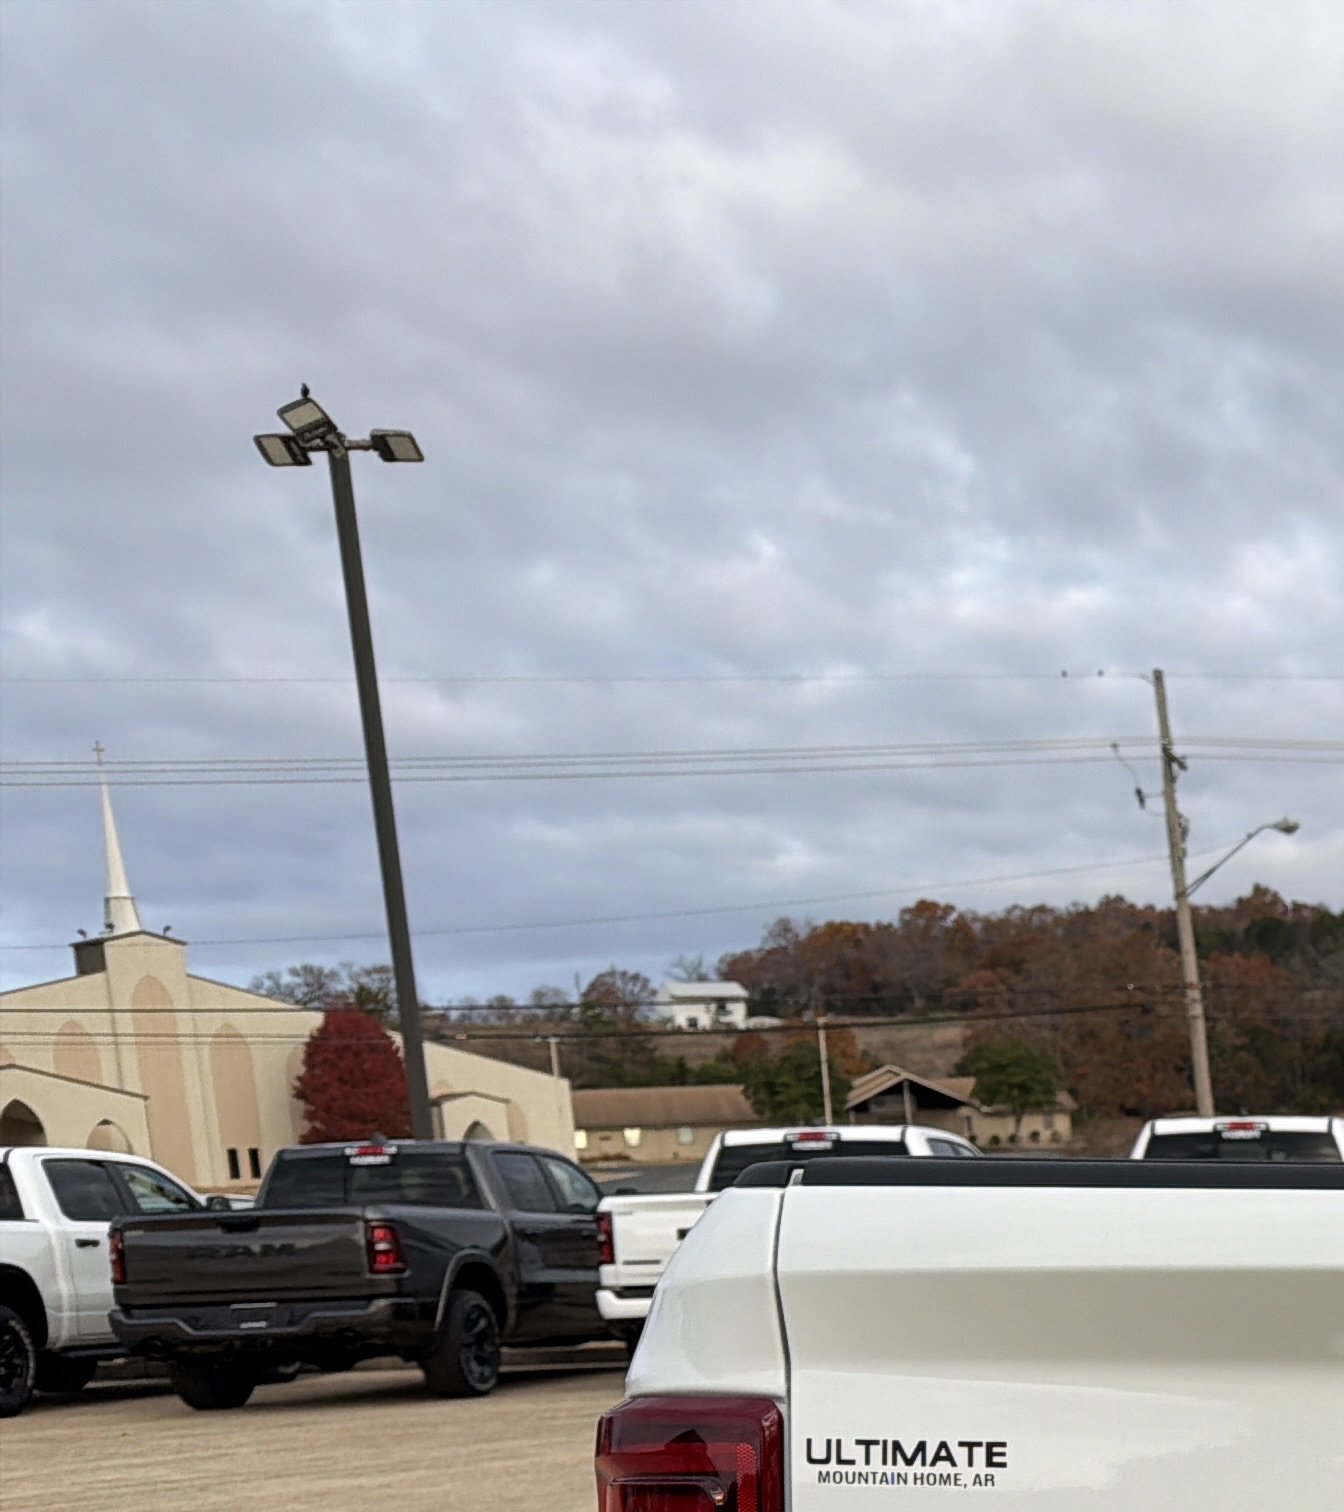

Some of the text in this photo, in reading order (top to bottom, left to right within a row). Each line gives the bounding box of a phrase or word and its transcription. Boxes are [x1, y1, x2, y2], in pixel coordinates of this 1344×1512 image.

[806, 1438, 1007, 1468] ULTIMATE
[817, 1470, 996, 1488] MOUNTAIN HOME, AR
